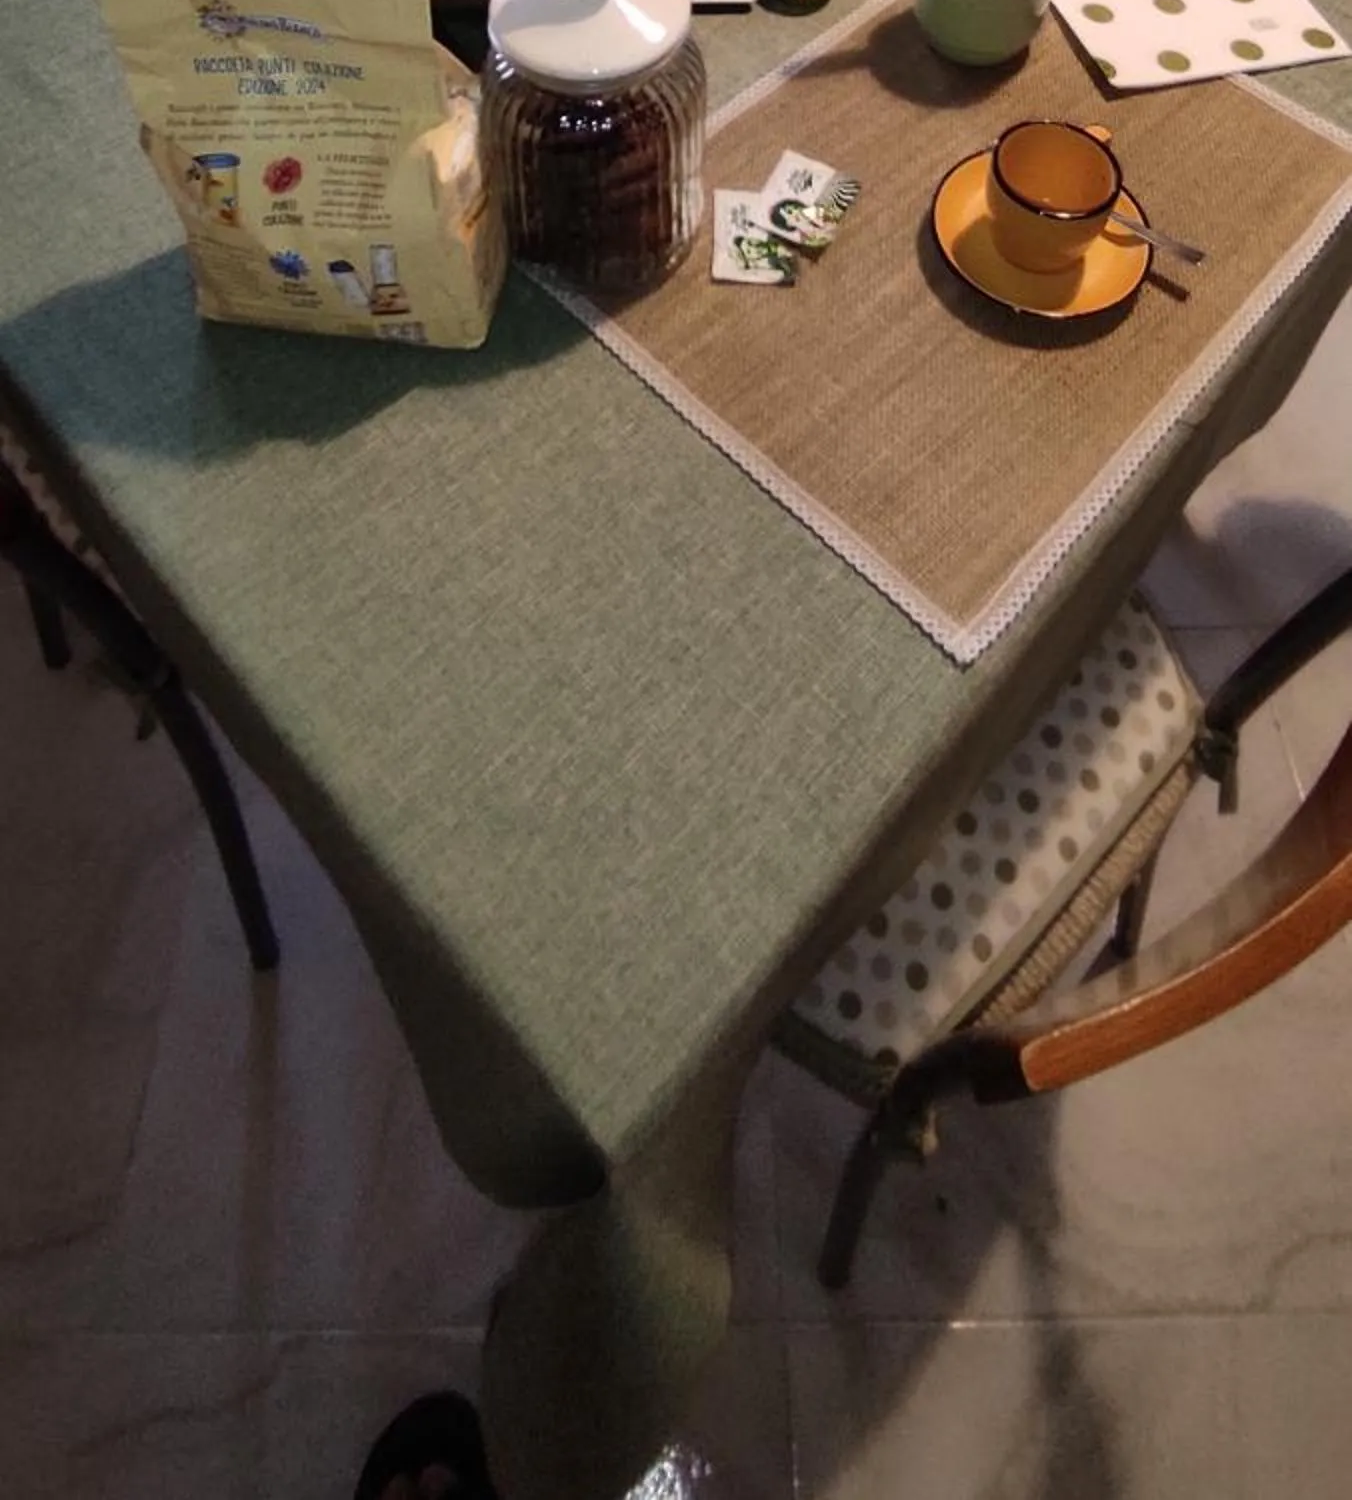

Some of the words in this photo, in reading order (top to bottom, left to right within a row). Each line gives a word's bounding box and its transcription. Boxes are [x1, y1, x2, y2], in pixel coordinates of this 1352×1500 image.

[193, 56, 253, 75] RACCOLTA
[258, 57, 296, 76] PUNTI
[303, 60, 365, 80] COLAZIONE
[238, 78, 286, 96] EDIZIONE
[296, 79, 327, 95] 2024
